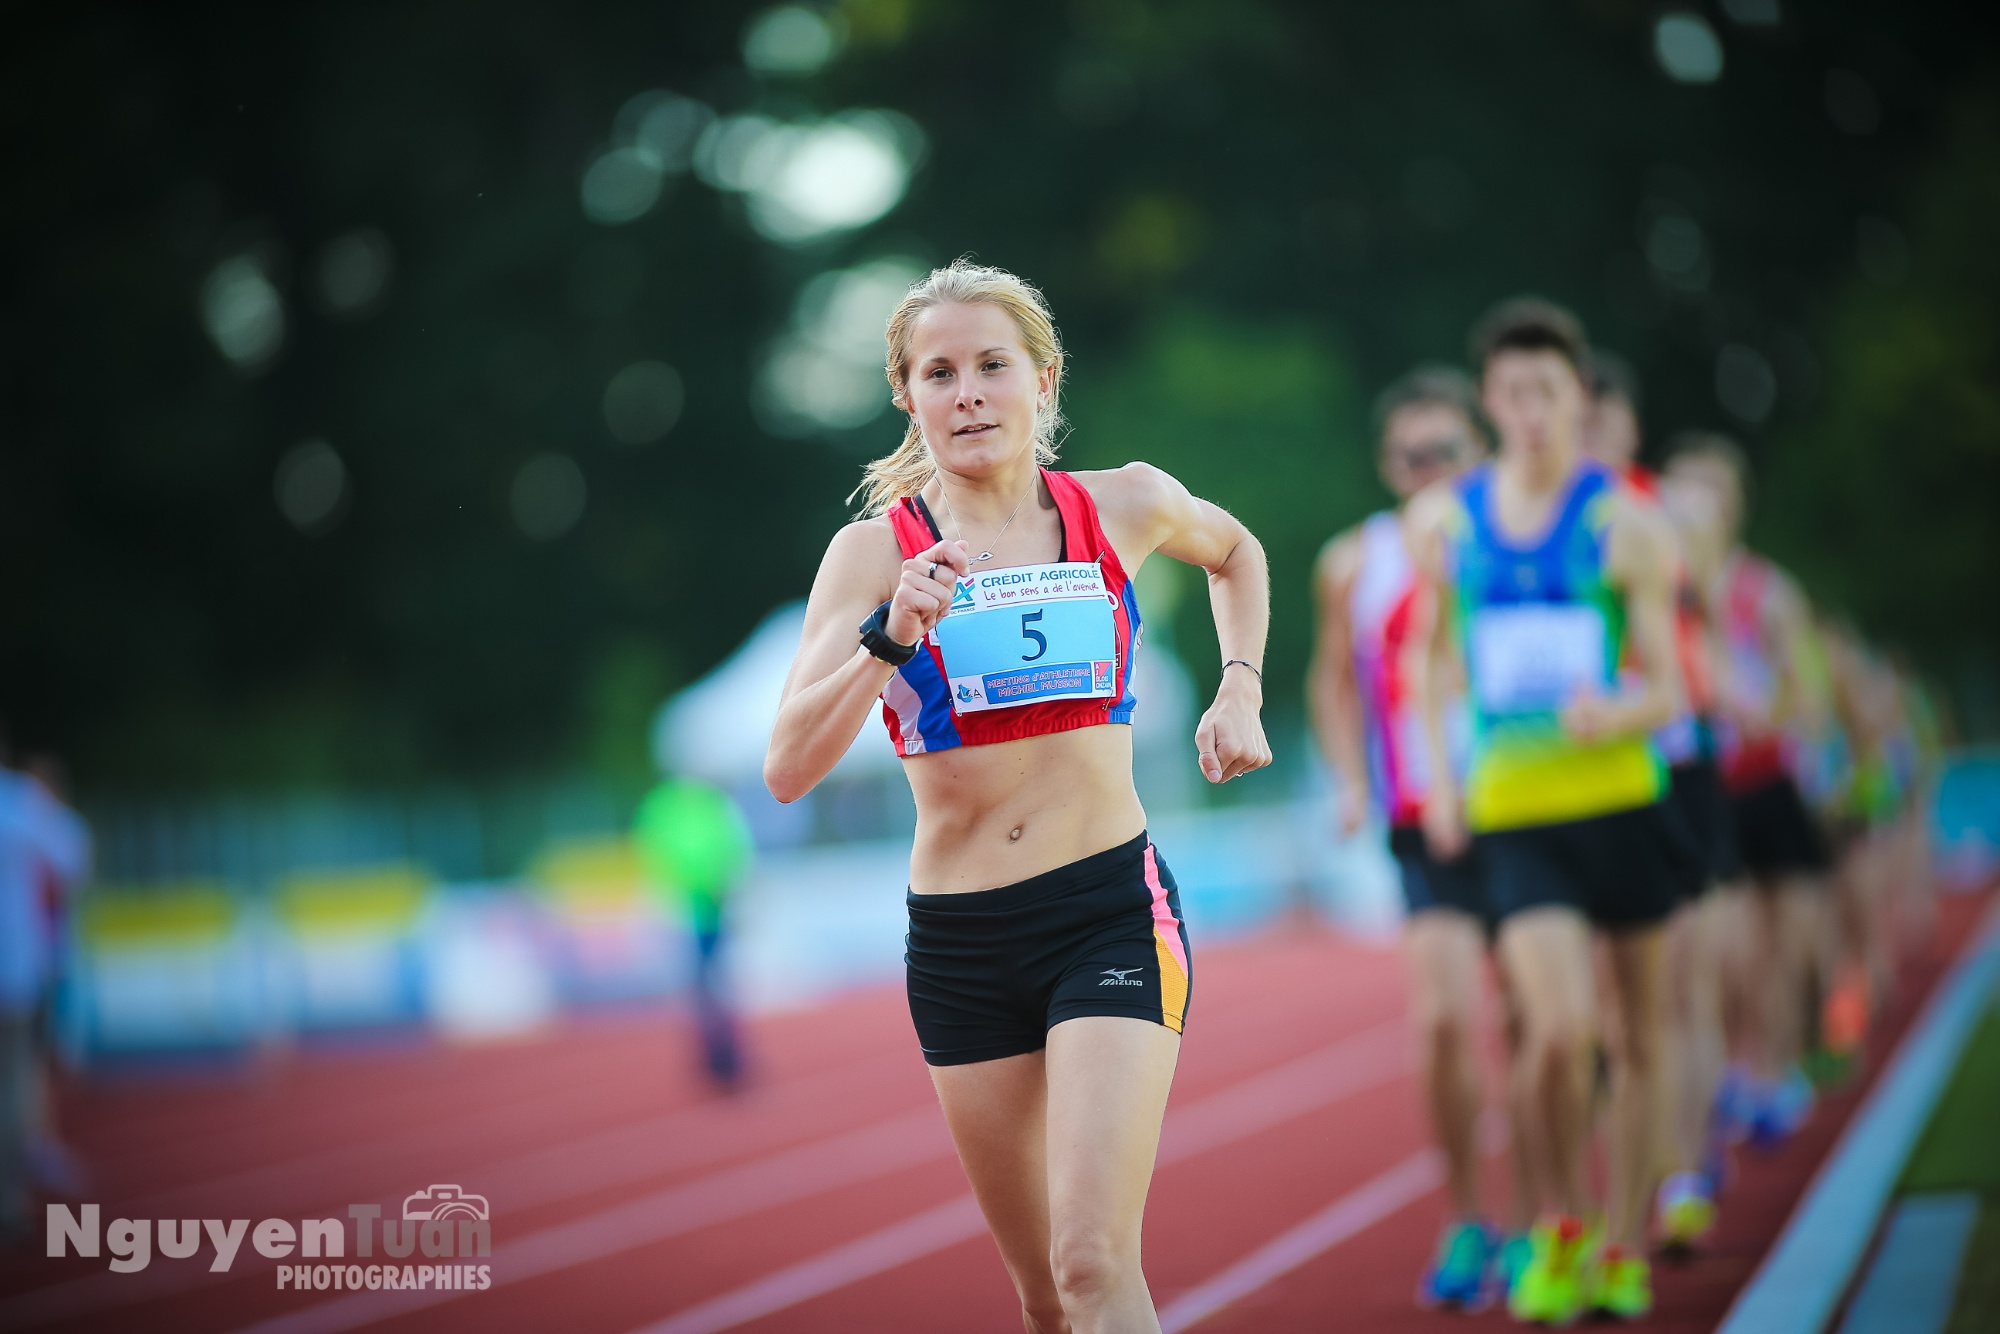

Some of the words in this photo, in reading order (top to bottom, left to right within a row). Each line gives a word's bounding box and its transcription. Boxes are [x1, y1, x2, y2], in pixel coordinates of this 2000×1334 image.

[981, 572, 1033, 588] CRÉDIT
[1039, 569, 1101, 581] AGRICOLE
[984, 590, 996, 601] Le
[999, 588, 1017, 599] bon
[1020, 586, 1039, 596] sens
[1052, 583, 1063, 593] de
[1021, 608, 1048, 661] 5
[987, 674, 1030, 689] MEETING
[998, 683, 1039, 698] MICHEL
[1041, 678, 1082, 691] MUSSON
